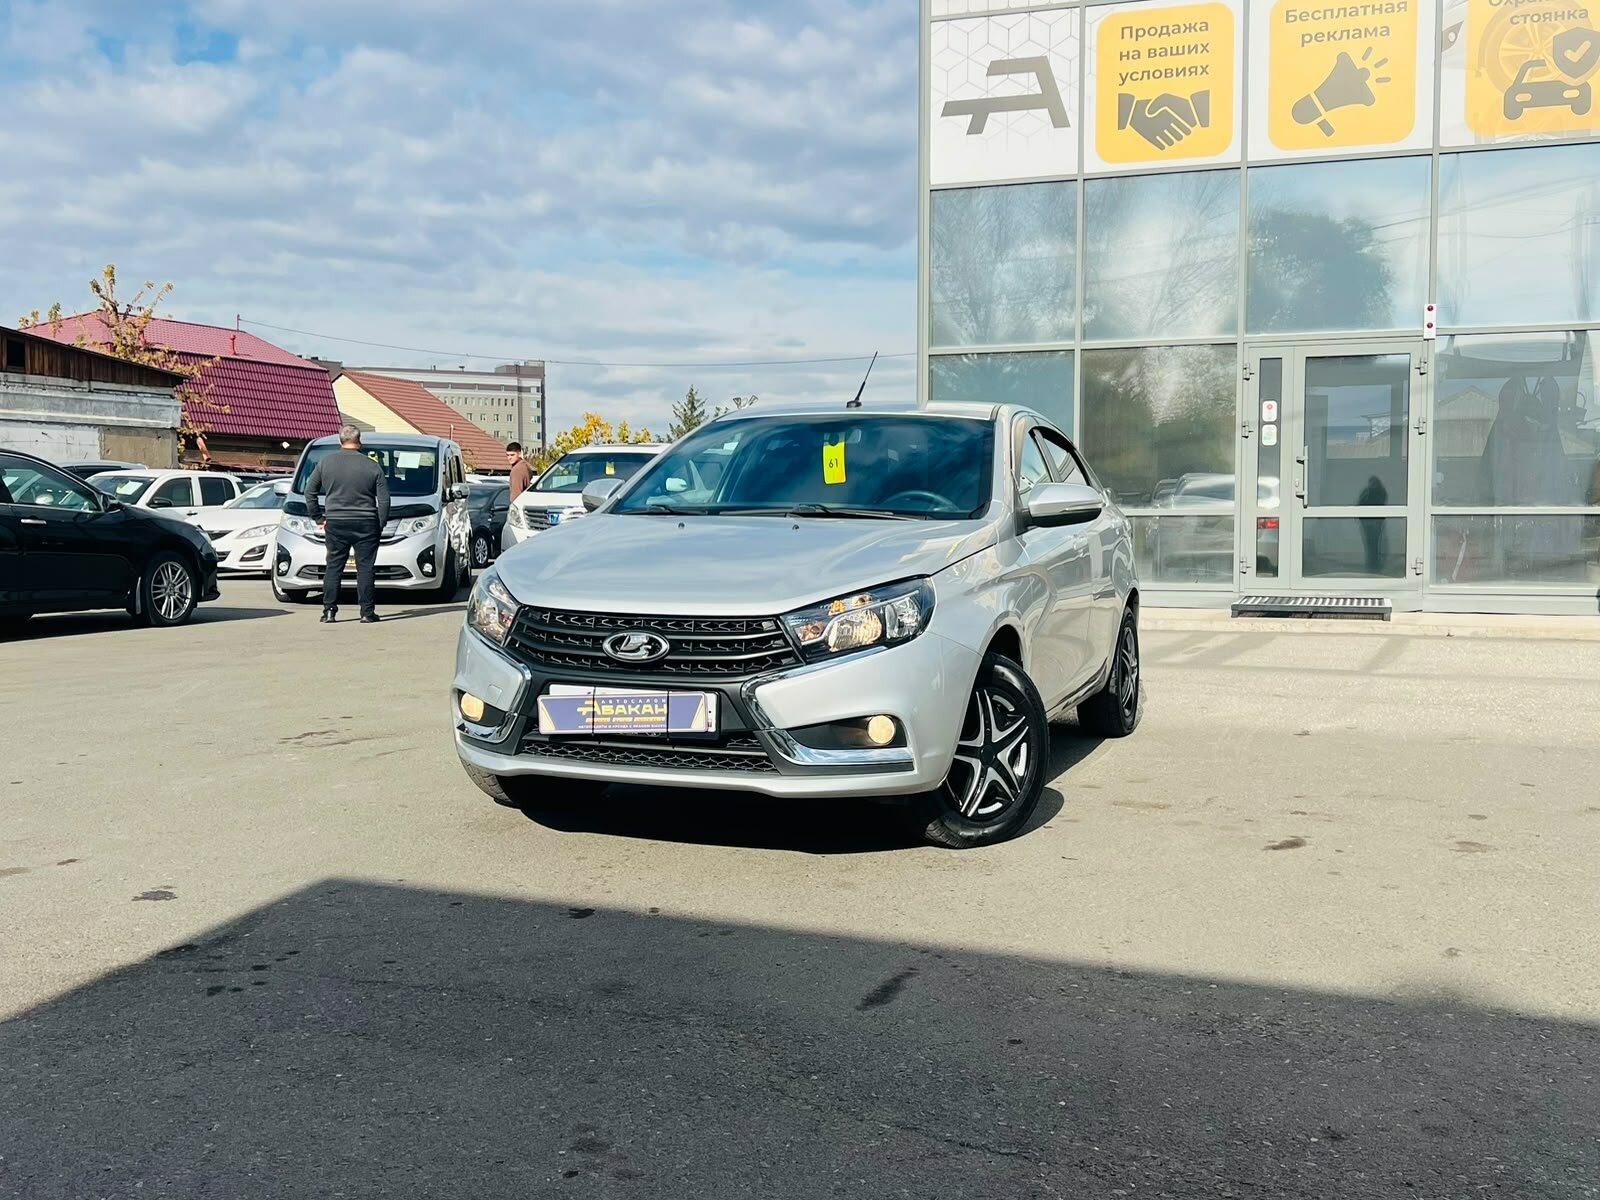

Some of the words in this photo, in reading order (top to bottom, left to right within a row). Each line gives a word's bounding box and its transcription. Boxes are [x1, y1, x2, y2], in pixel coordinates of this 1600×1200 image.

[1285, 1, 1408, 23] Бесплатная
[1510, 8, 1589, 25] стоянка
[1121, 21, 1209, 41] Продажа
[1301, 25, 1391, 47] реклама
[1119, 49, 1141, 61] на
[1147, 42, 1210, 59] ваших
[1118, 64, 1210, 86] условиях
[828, 458, 839, 469] 61
